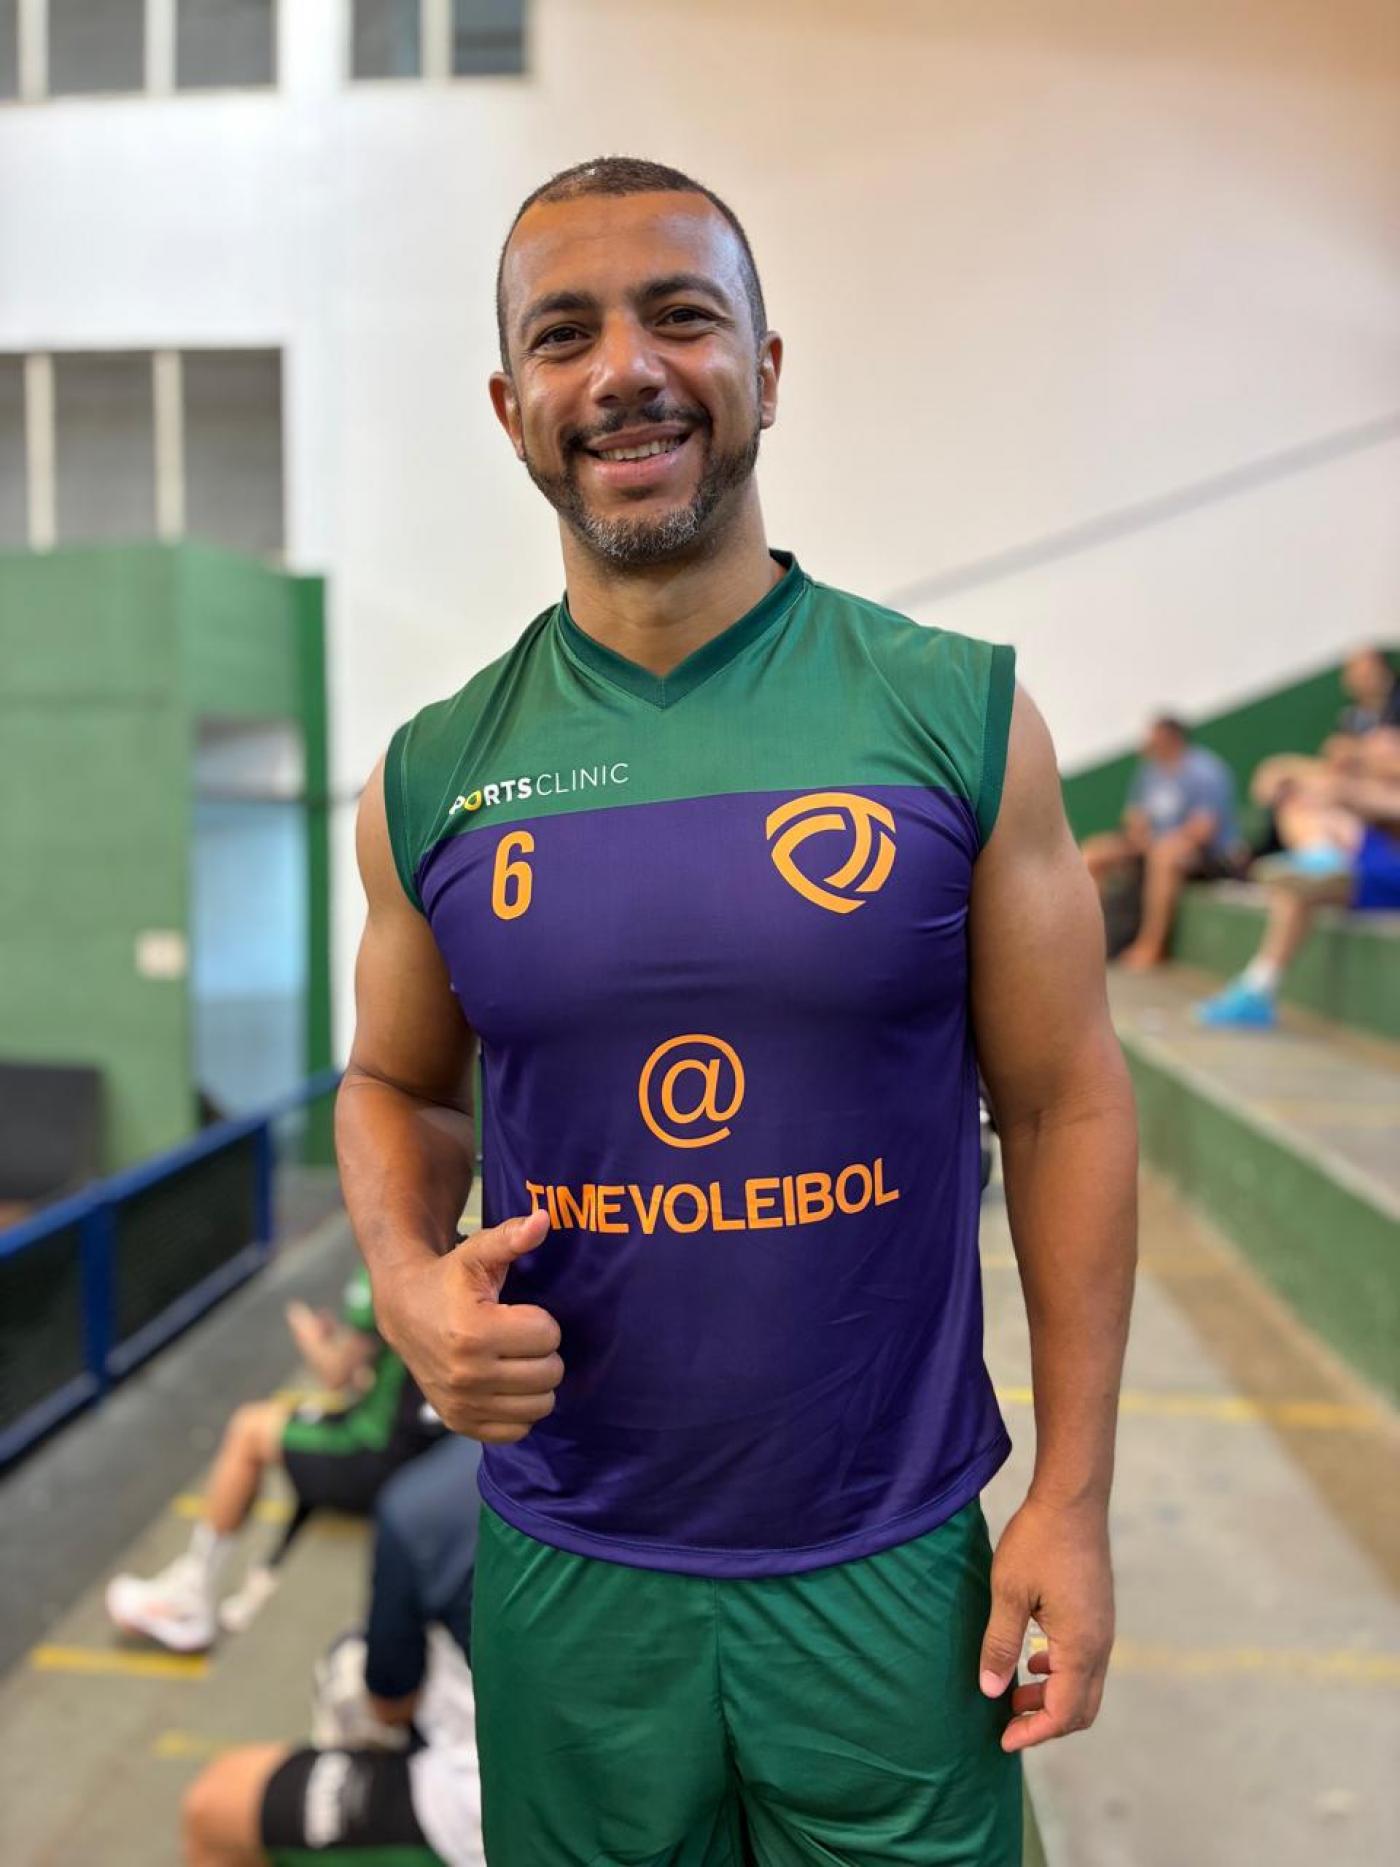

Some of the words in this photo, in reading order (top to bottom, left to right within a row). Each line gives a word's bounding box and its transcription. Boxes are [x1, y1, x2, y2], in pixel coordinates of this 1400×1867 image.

[492, 830, 534, 920] 6
[638, 1033, 745, 1149] @
[526, 1157, 900, 1234] TIMEVOLEIBOL
